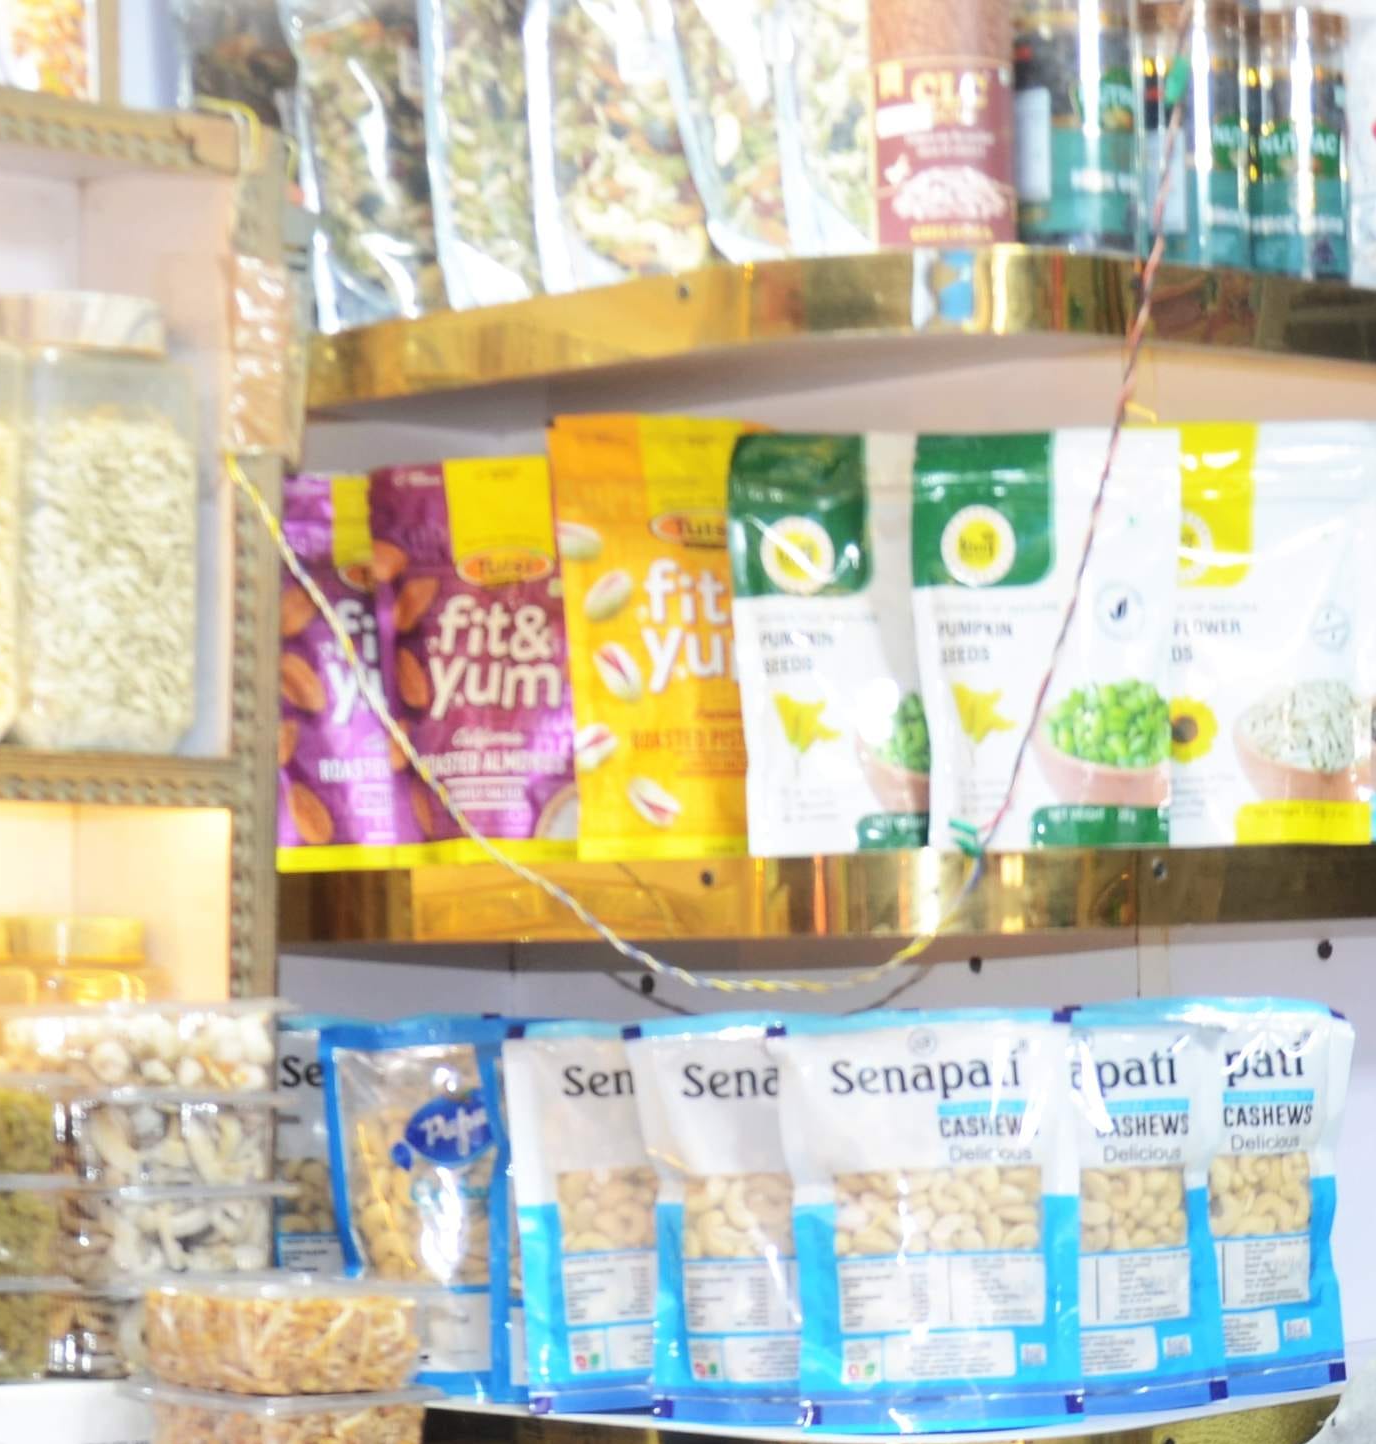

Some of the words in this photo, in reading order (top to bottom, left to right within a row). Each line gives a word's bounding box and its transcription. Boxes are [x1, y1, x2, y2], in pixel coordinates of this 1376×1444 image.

[437, 594, 553, 662] fit&
[937, 619, 1015, 639] PUMPKIN
[428, 657, 561, 720] yum
[831, 1050, 1021, 1099] Senapai
[1223, 1104, 1315, 1129] CASHEWS
[1102, 1143, 1183, 1164] Delicious
[1230, 1132, 1301, 1153] Delicious
